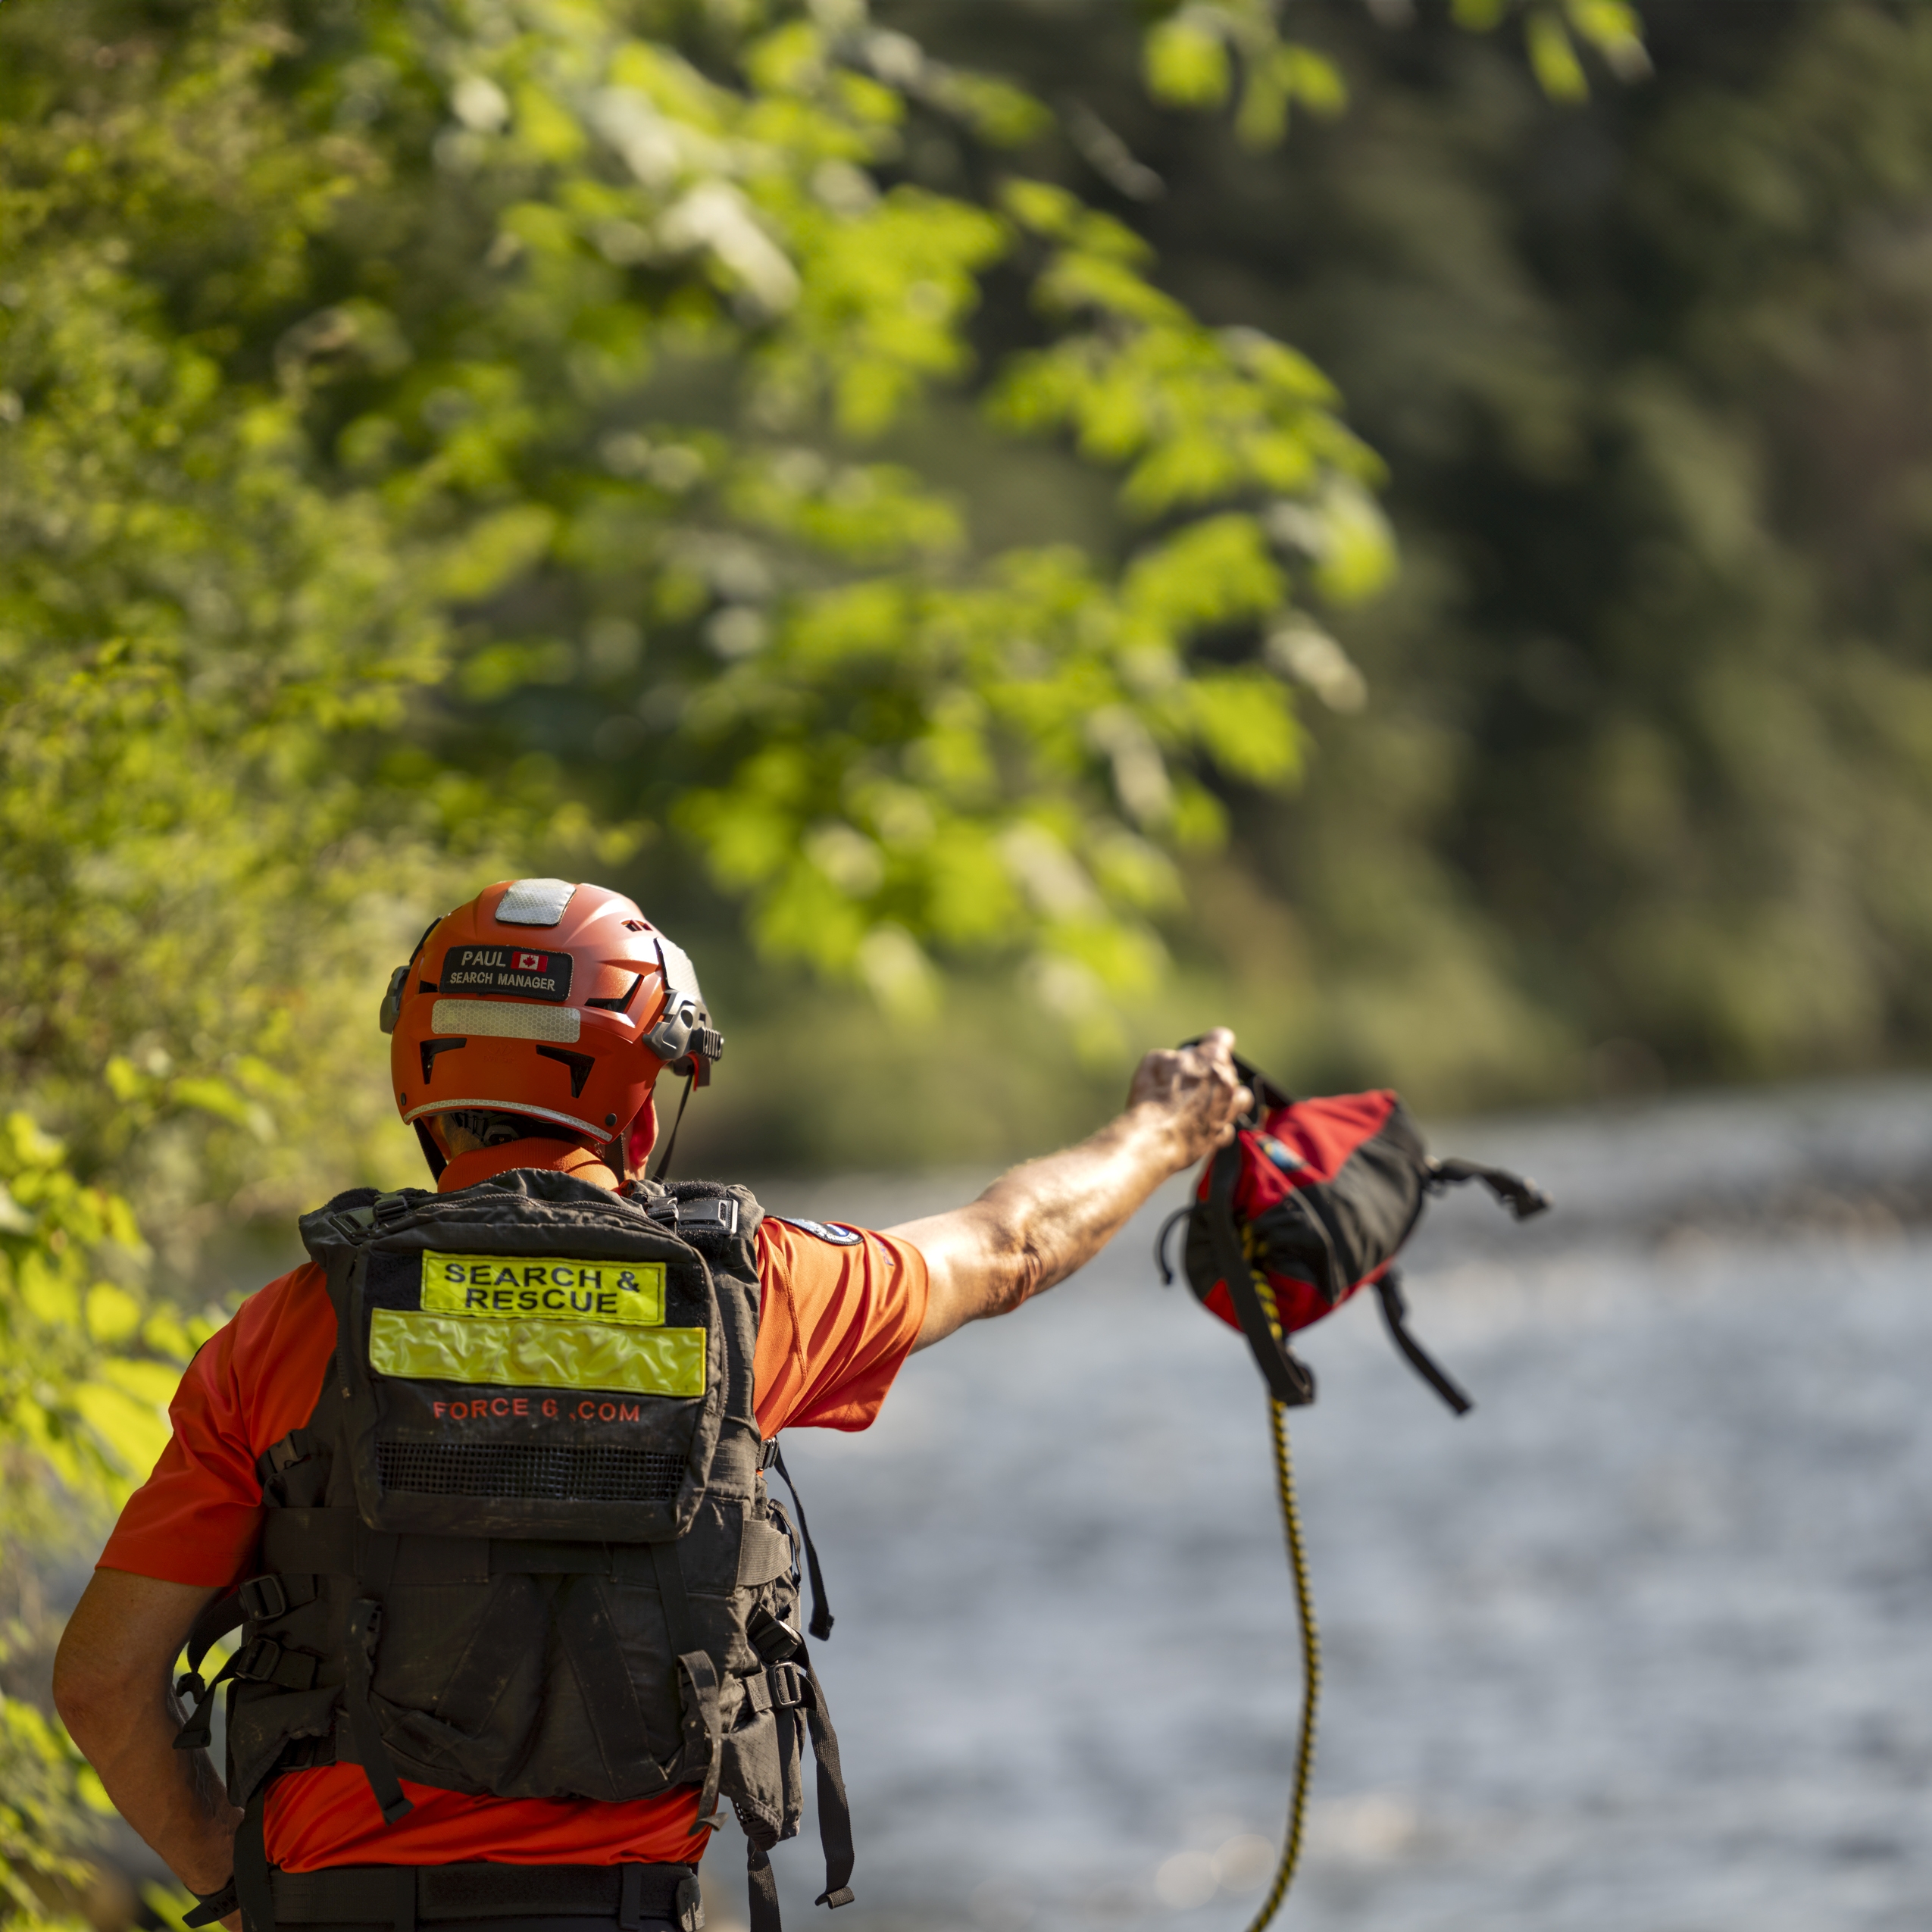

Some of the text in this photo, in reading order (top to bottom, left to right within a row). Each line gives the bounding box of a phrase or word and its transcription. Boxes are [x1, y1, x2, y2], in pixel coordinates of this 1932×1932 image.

[461, 950, 506, 968] PAUL
[449, 971, 555, 992] SEARCH MANAGER
[444, 1262, 641, 1293] SEARCH &
[464, 1287, 617, 1314] RESCUE
[433, 1397, 529, 1420] FORCE
[541, 1398, 559, 1418] 6
